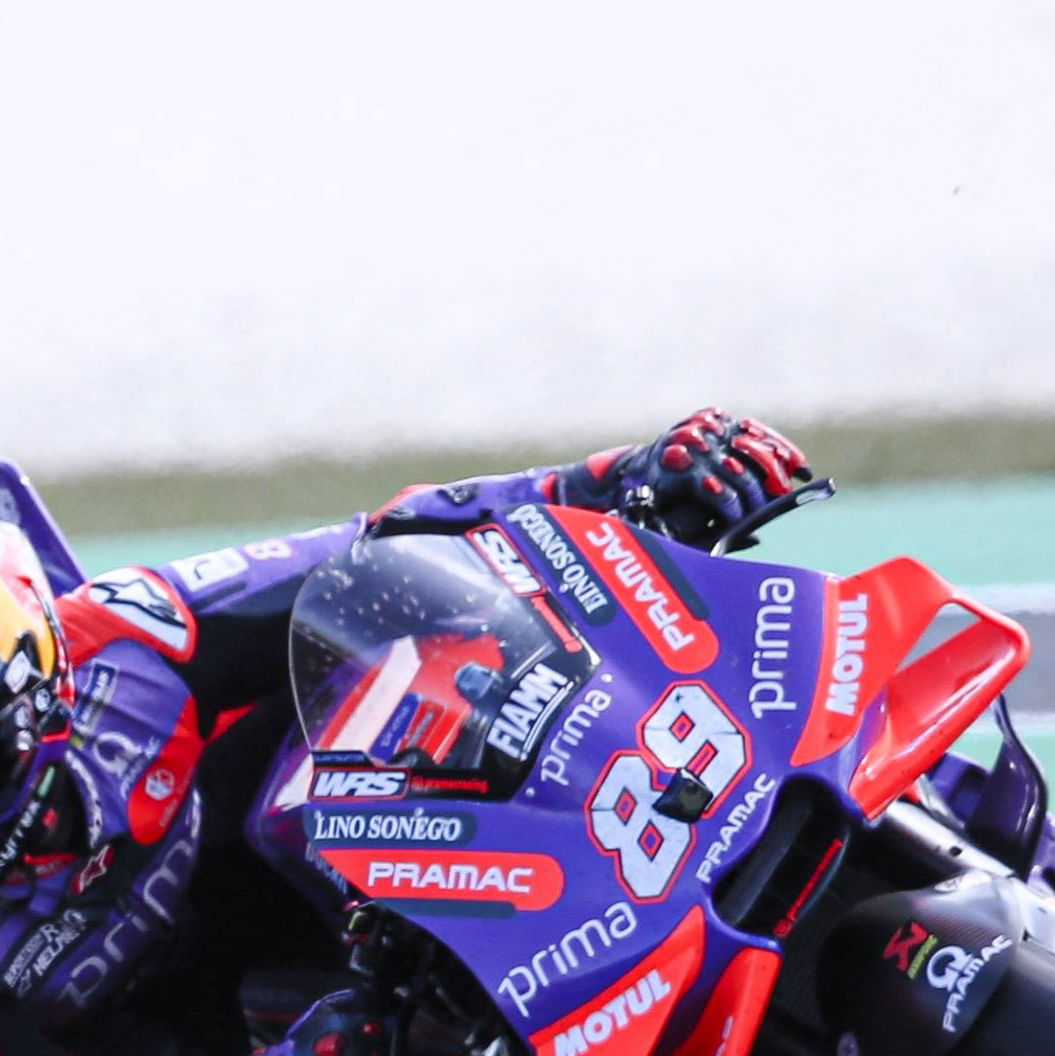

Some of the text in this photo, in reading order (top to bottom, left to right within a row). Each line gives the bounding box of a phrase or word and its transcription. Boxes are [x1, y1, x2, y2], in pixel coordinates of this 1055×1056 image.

[472, 531, 541, 593] WRS
[586, 522, 695, 651] PRAMAC
[749, 577, 797, 719] prima
[825, 593, 869, 717] MOTUL
[487, 663, 569, 758] FIAMM
[541, 689, 612, 786] prima
[313, 772, 406, 796] WRS
[314, 813, 365, 840] LINO
[587, 682, 750, 901] 89
[696, 773, 776, 883] PRAMAC
[368, 861, 533, 893] PRAMAC
[498, 901, 638, 1018] prima
[943, 934, 1013, 1033] PRAMAC
